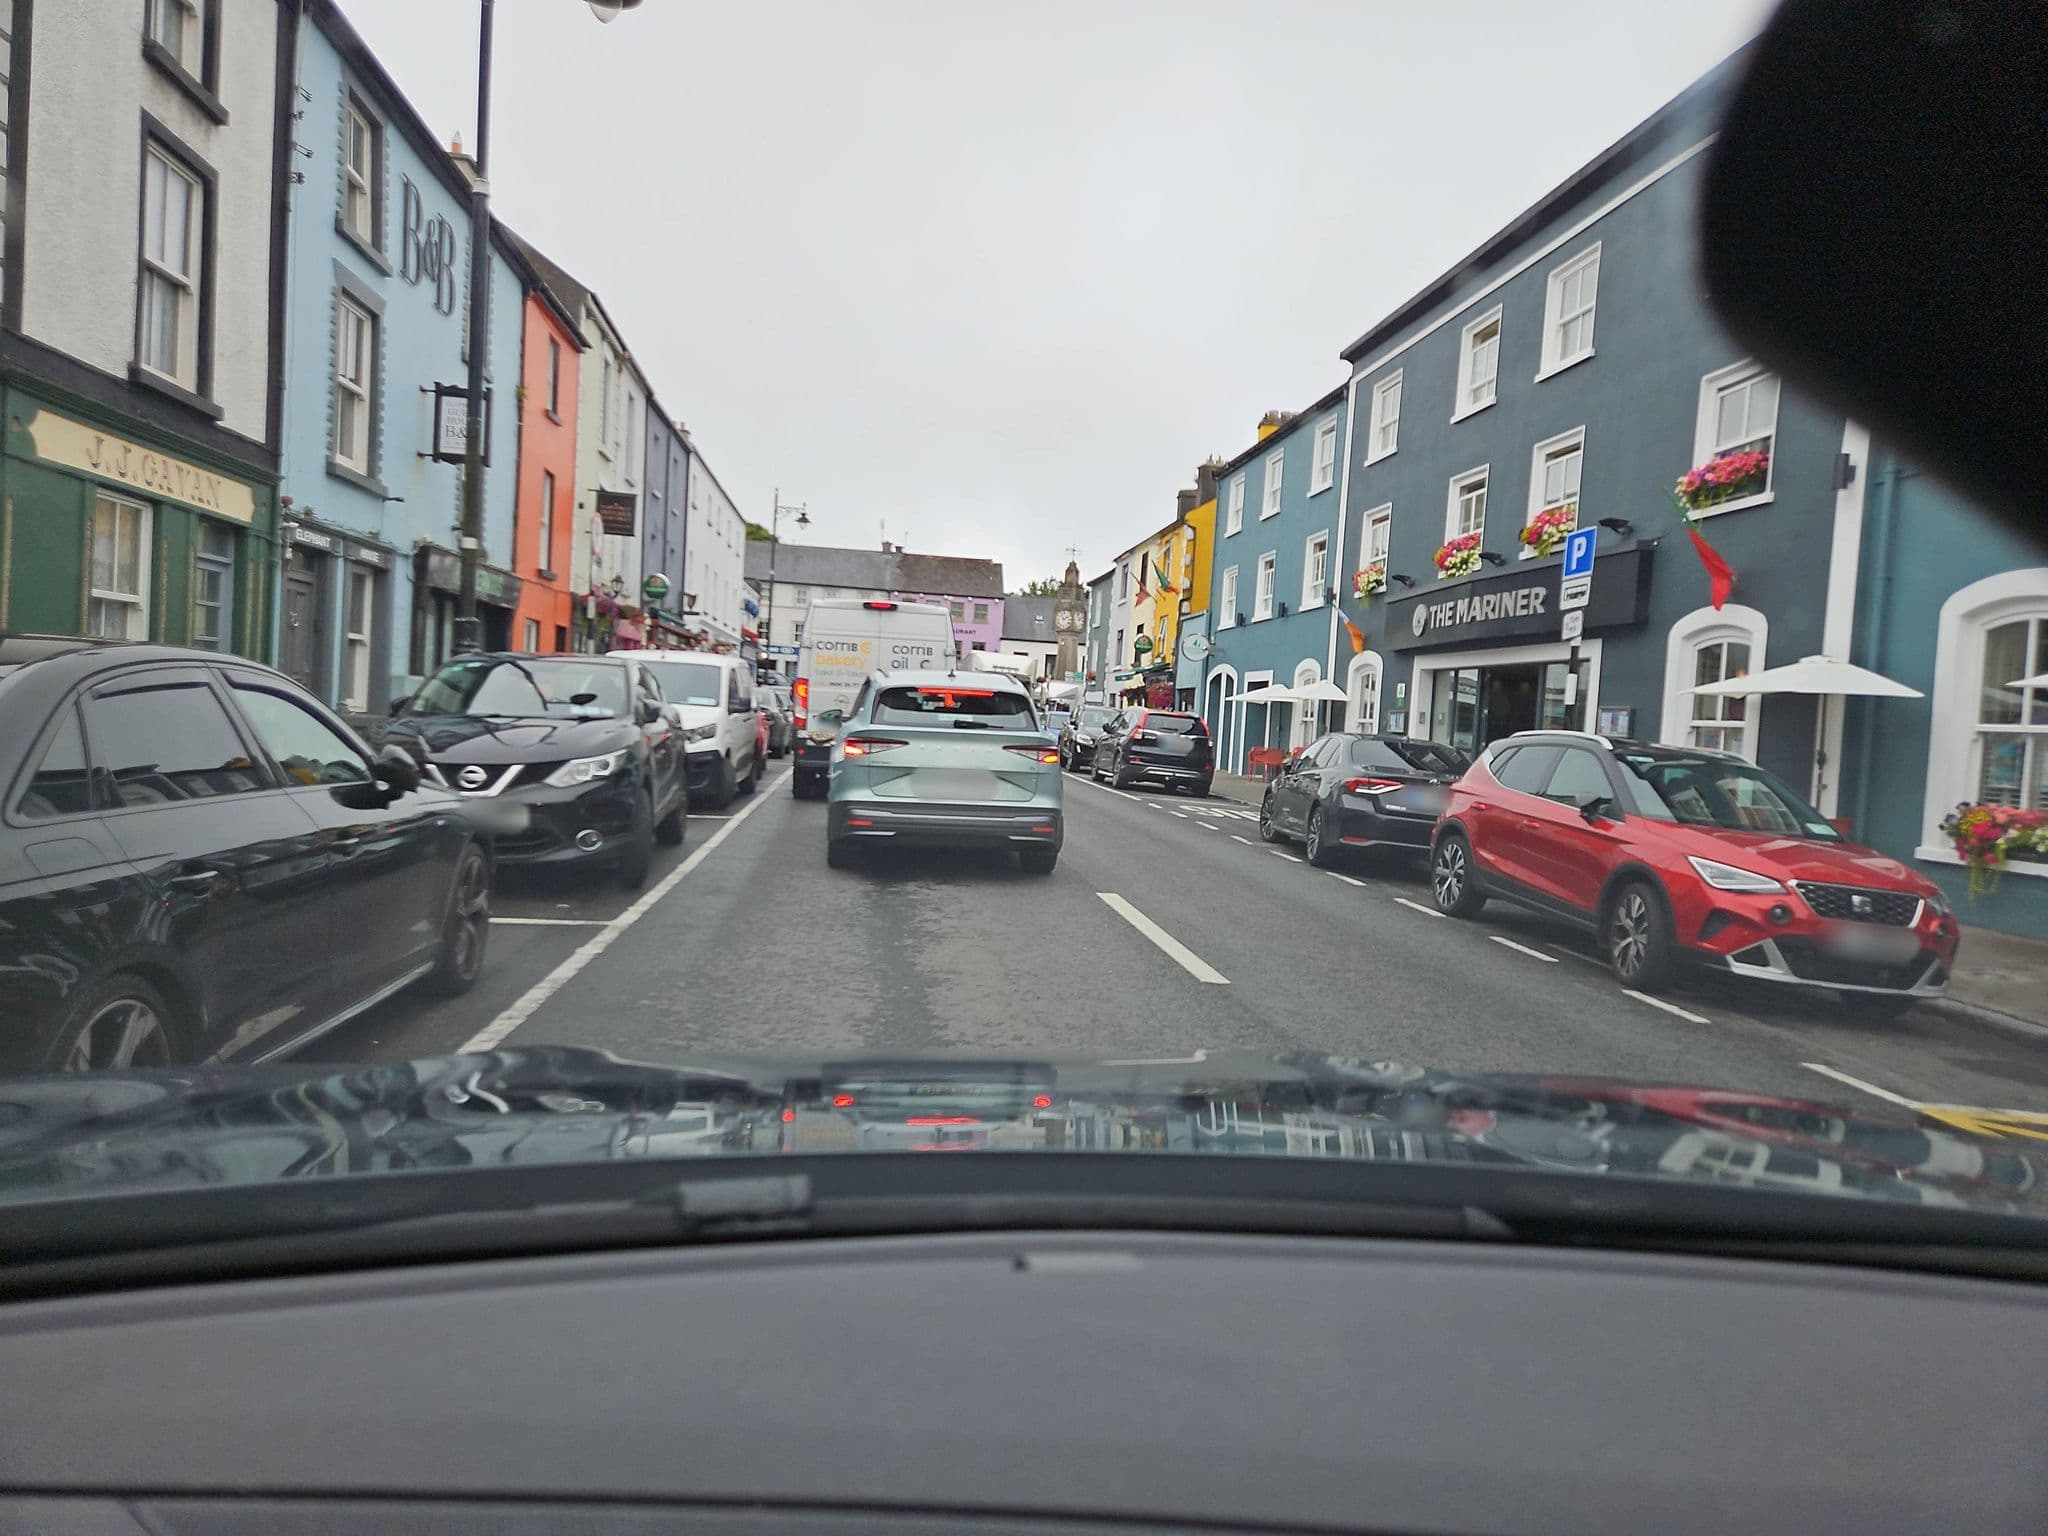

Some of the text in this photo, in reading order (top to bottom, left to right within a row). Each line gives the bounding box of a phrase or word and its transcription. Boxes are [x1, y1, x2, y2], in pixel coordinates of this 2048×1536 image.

[400, 172, 456, 316] B&B
[296, 528, 331, 548] ELEPHANT
[1571, 536, 1587, 570] P
[1430, 601, 1455, 629] THE
[1456, 586, 1547, 625] MARINER
[891, 657, 908, 670] oil
